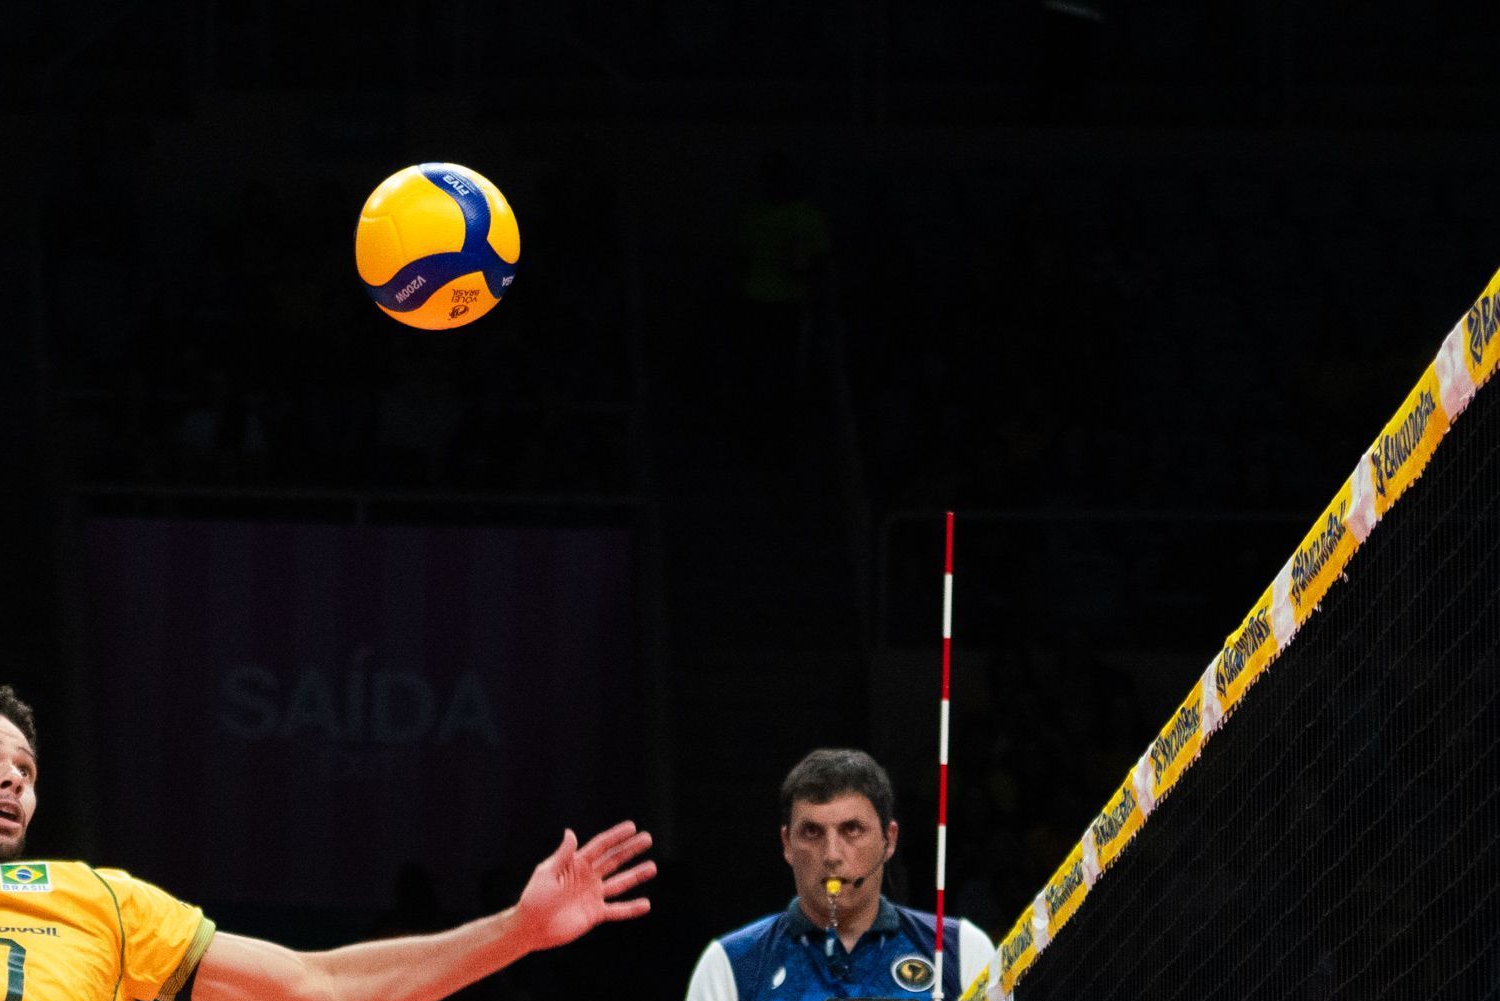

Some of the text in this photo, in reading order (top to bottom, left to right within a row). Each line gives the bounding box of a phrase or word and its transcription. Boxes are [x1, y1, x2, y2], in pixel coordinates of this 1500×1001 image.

[442, 174, 470, 196] FIVB
[395, 275, 427, 303] V200W
[218, 646, 502, 746] SAÍDA
